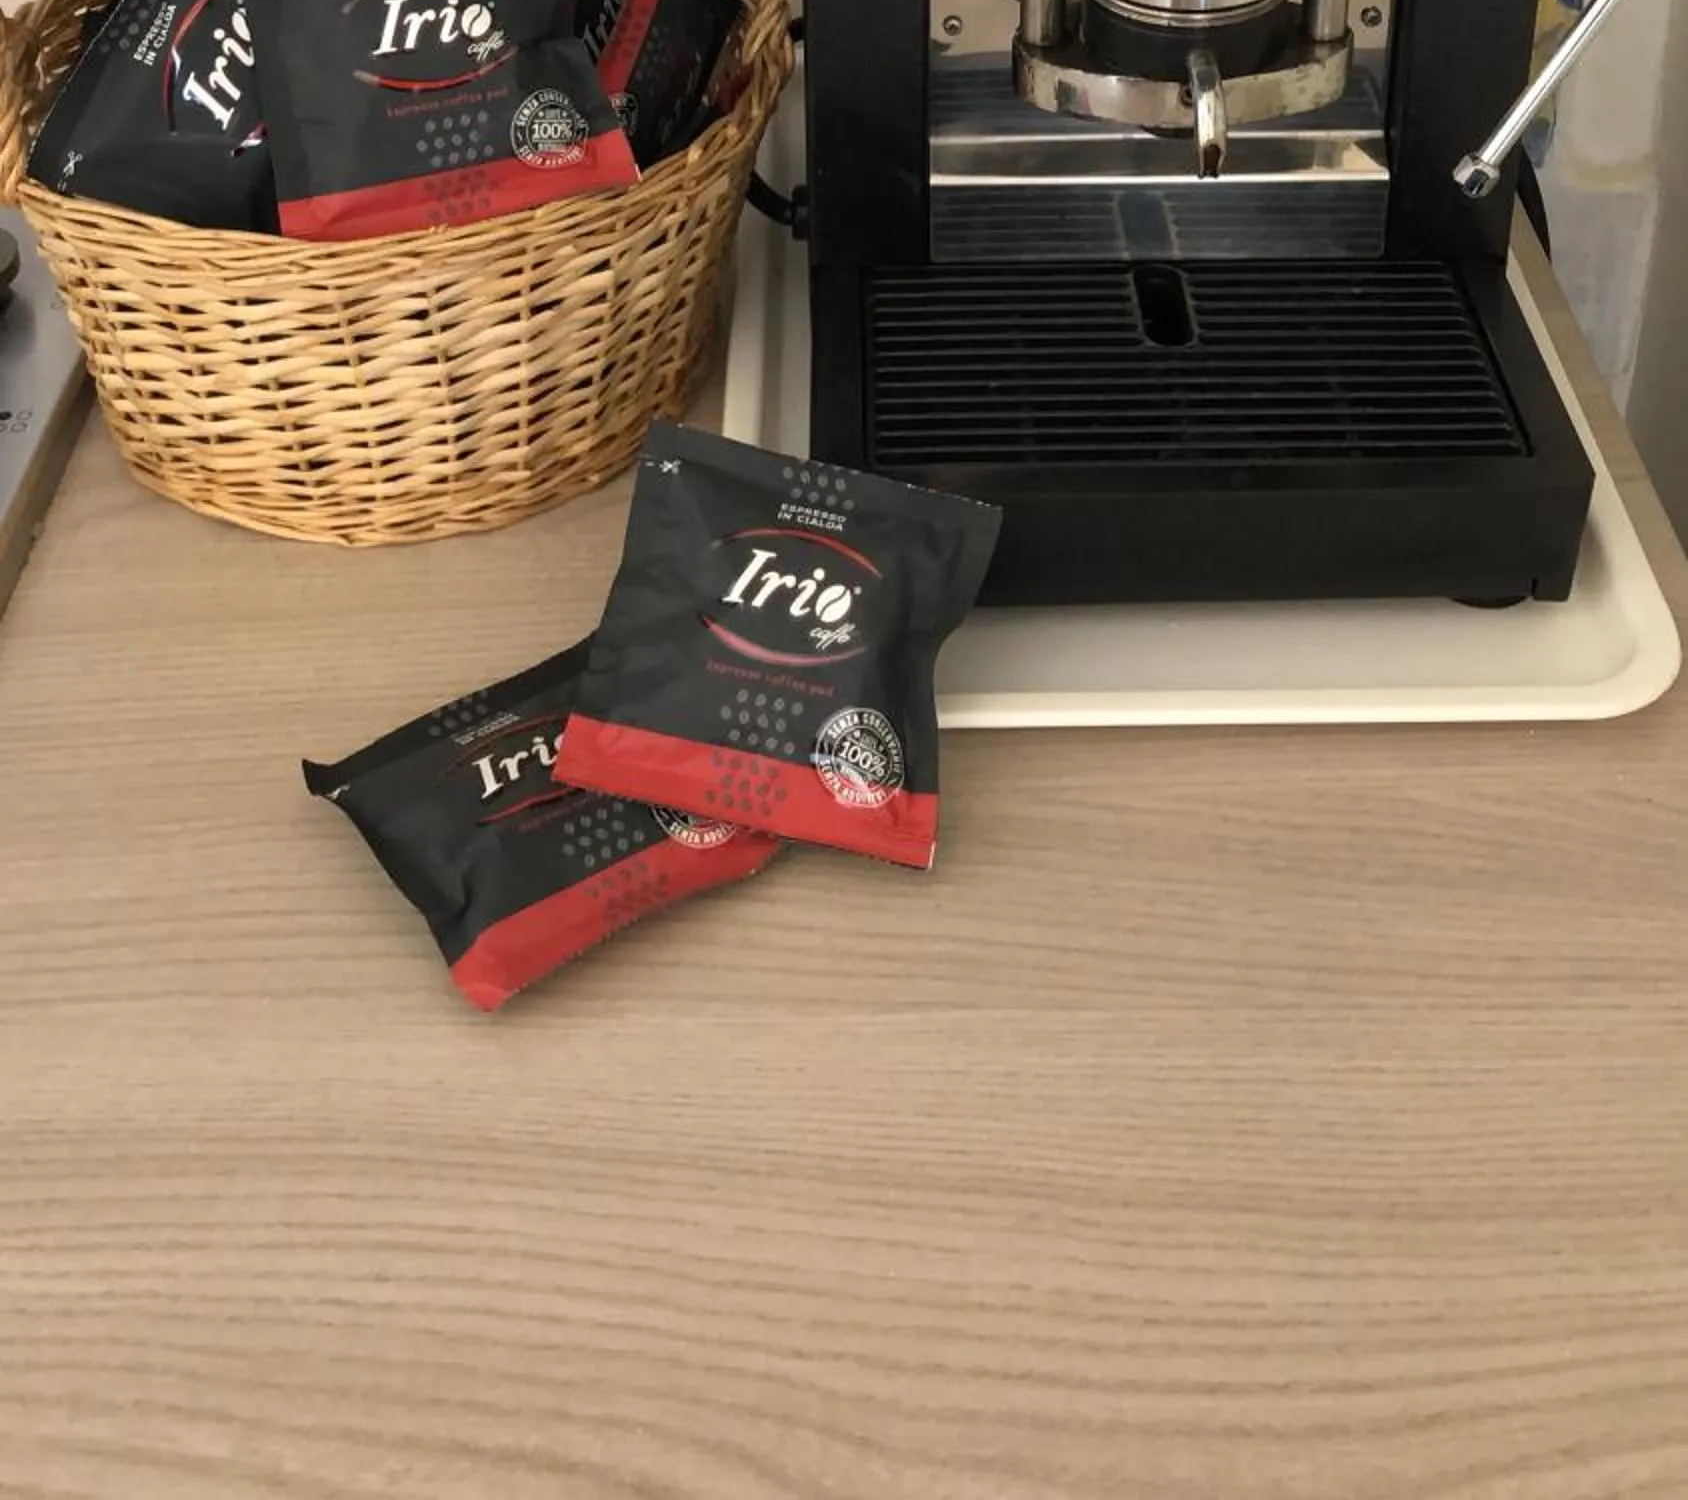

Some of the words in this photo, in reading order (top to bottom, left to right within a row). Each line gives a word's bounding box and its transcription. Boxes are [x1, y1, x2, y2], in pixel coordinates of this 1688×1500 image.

[531, 122, 573, 141] 100%
[777, 511, 791, 521] IN
[797, 512, 844, 533] CIALDA
[780, 502, 847, 524] ESPRESSO
[721, 548, 853, 624] Irio
[826, 711, 860, 740] SENZA
[838, 740, 887, 778] 100%
